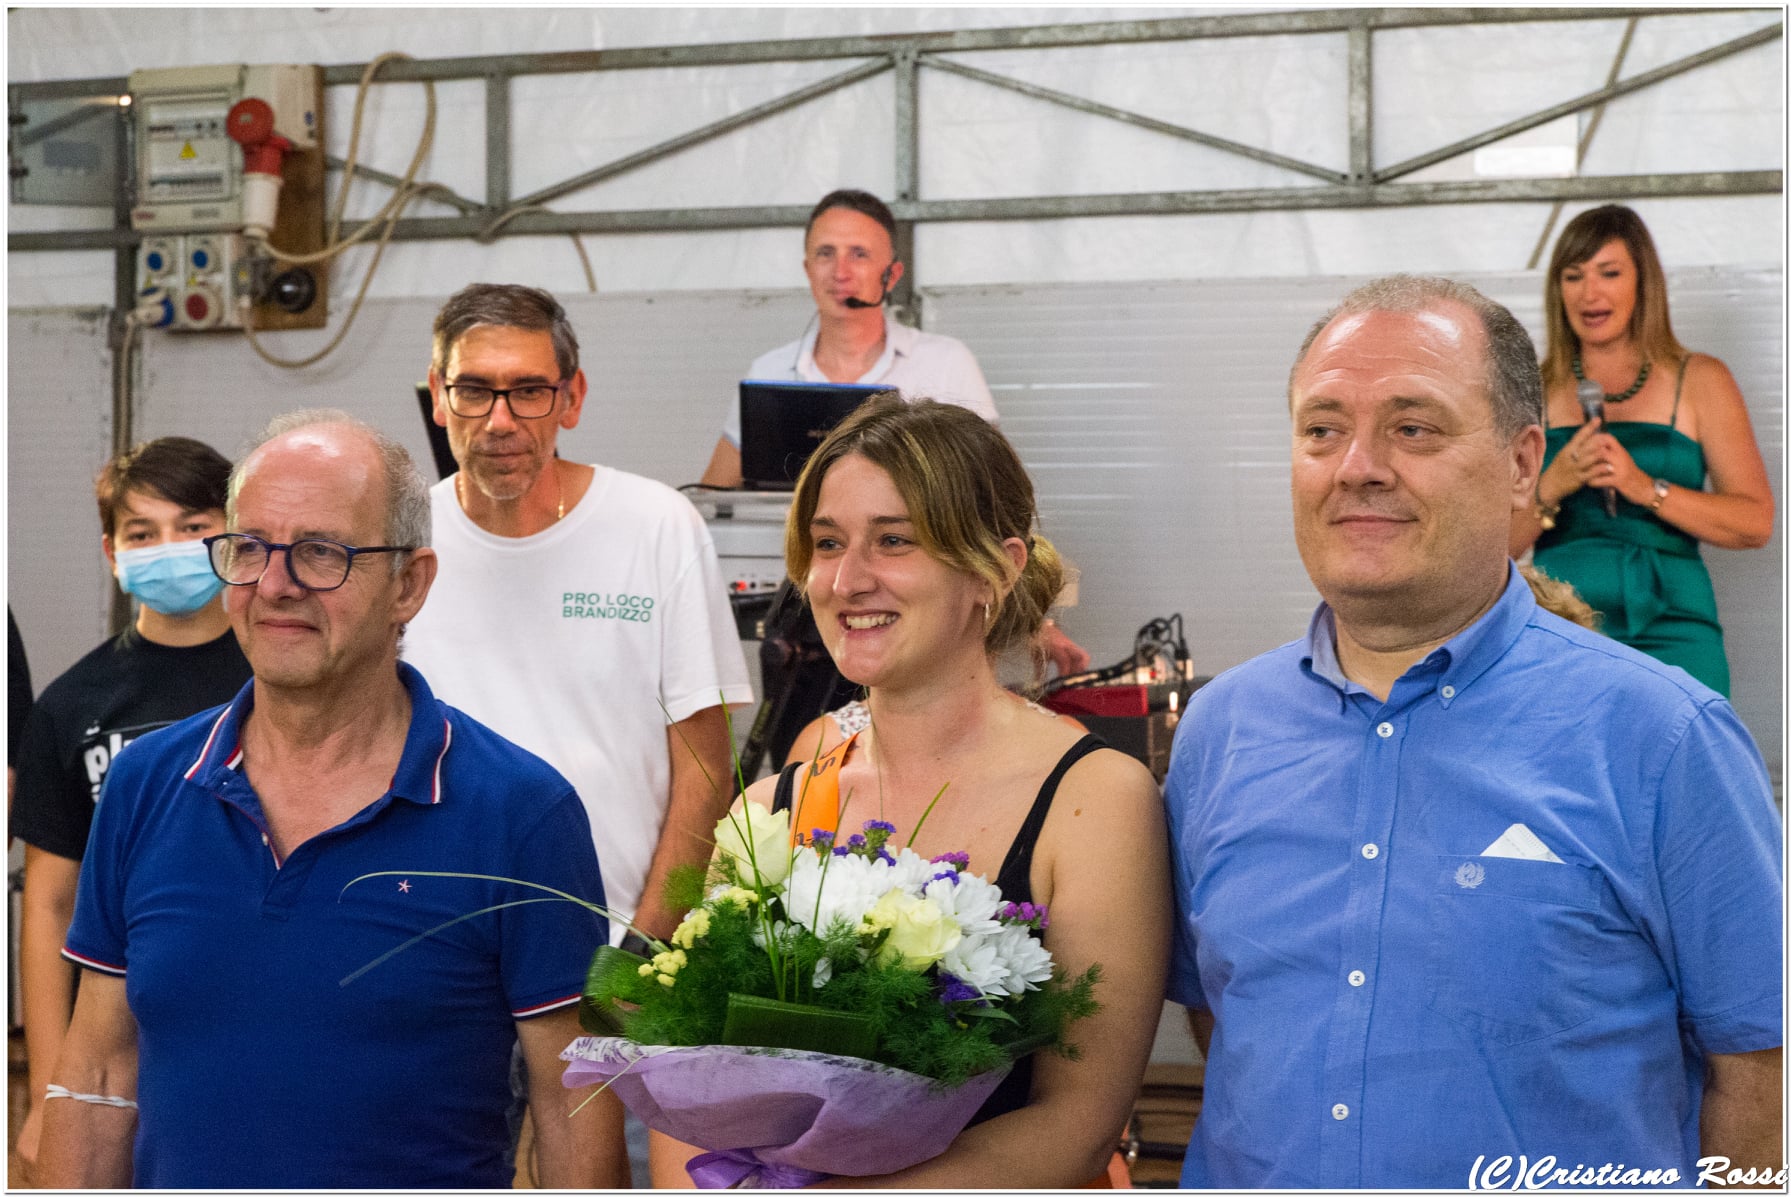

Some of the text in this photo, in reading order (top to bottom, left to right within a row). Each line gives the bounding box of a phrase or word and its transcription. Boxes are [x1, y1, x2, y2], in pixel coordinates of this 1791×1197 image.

[562, 592, 655, 610] PRO LOCO
[562, 605, 652, 623] BRANDIZZO
